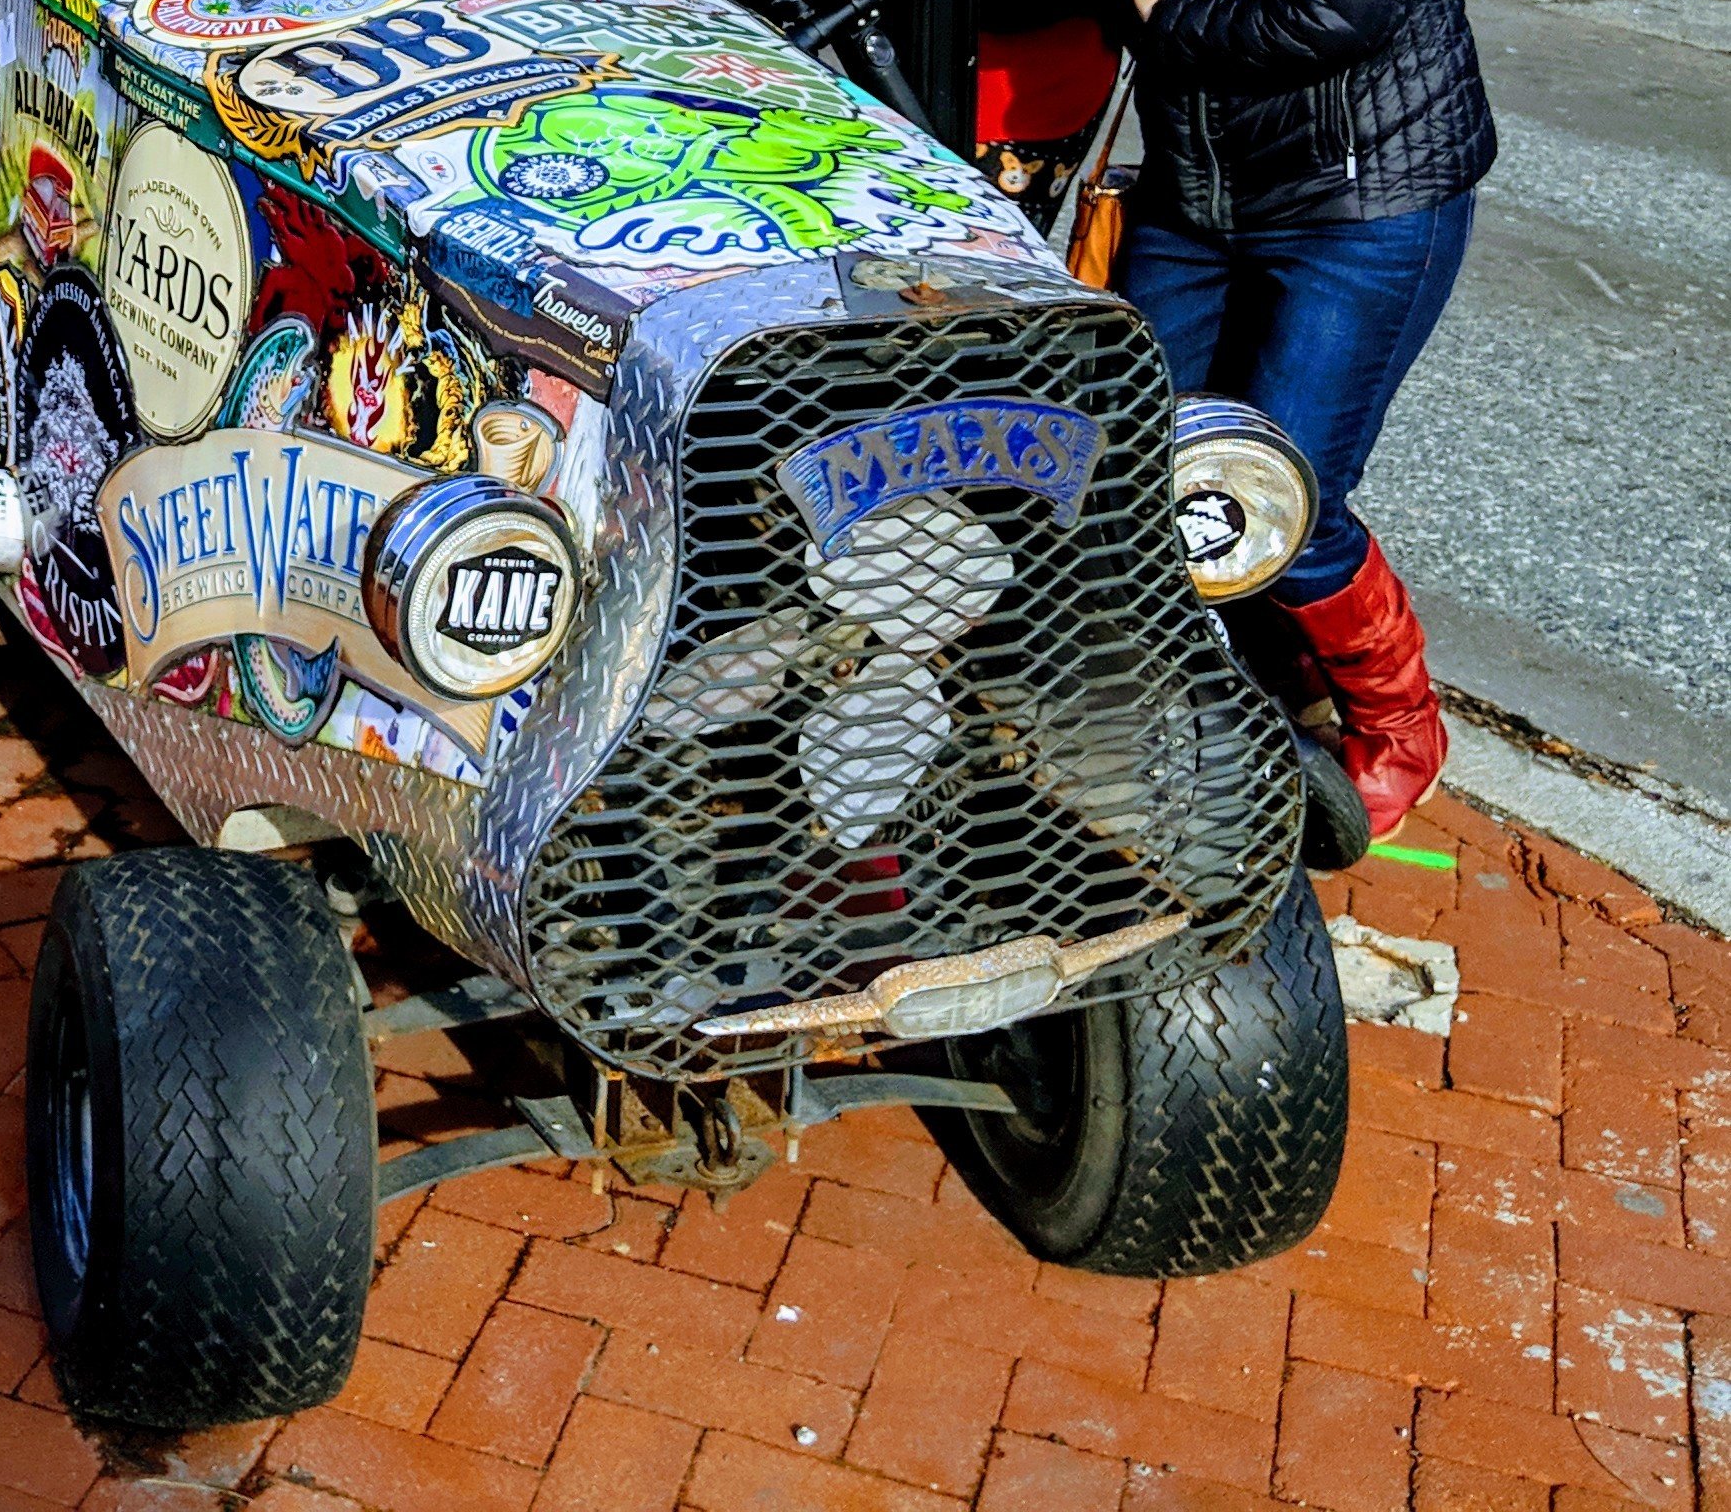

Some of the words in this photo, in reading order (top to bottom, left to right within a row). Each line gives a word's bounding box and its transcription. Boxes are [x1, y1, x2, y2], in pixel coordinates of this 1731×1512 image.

[15, 69, 41, 118] ALL
[43, 80, 75, 140] DAY
[76, 107, 100, 178] IPA
[120, 76, 189, 131] MAINSTREAM!
[140, 74, 178, 107] FLOAT
[178, 96, 202, 120] THE
[323, 91, 426, 140] DEVILS
[424, 61, 581, 99] BACKBONE
[378, 102, 477, 143] BREWING
[127, 180, 200, 216] PHILADELPHIA'S
[200, 213, 223, 252] OWN
[115, 212, 234, 340] YARDS
[110, 286, 157, 337] BREWING
[159, 321, 219, 375] COMPANY
[532, 272, 614, 349] Traveler
[133, 341, 154, 368] EST.
[155, 356, 179, 382] 1994
[118, 445, 389, 645] SWEETWATE
[484, 557, 535, 569] BREWING
[162, 568, 247, 613] BREWING
[287, 574, 363, 619] COMPA
[448, 568, 559, 631] KANE
[467, 632, 522, 643] COMPANY
